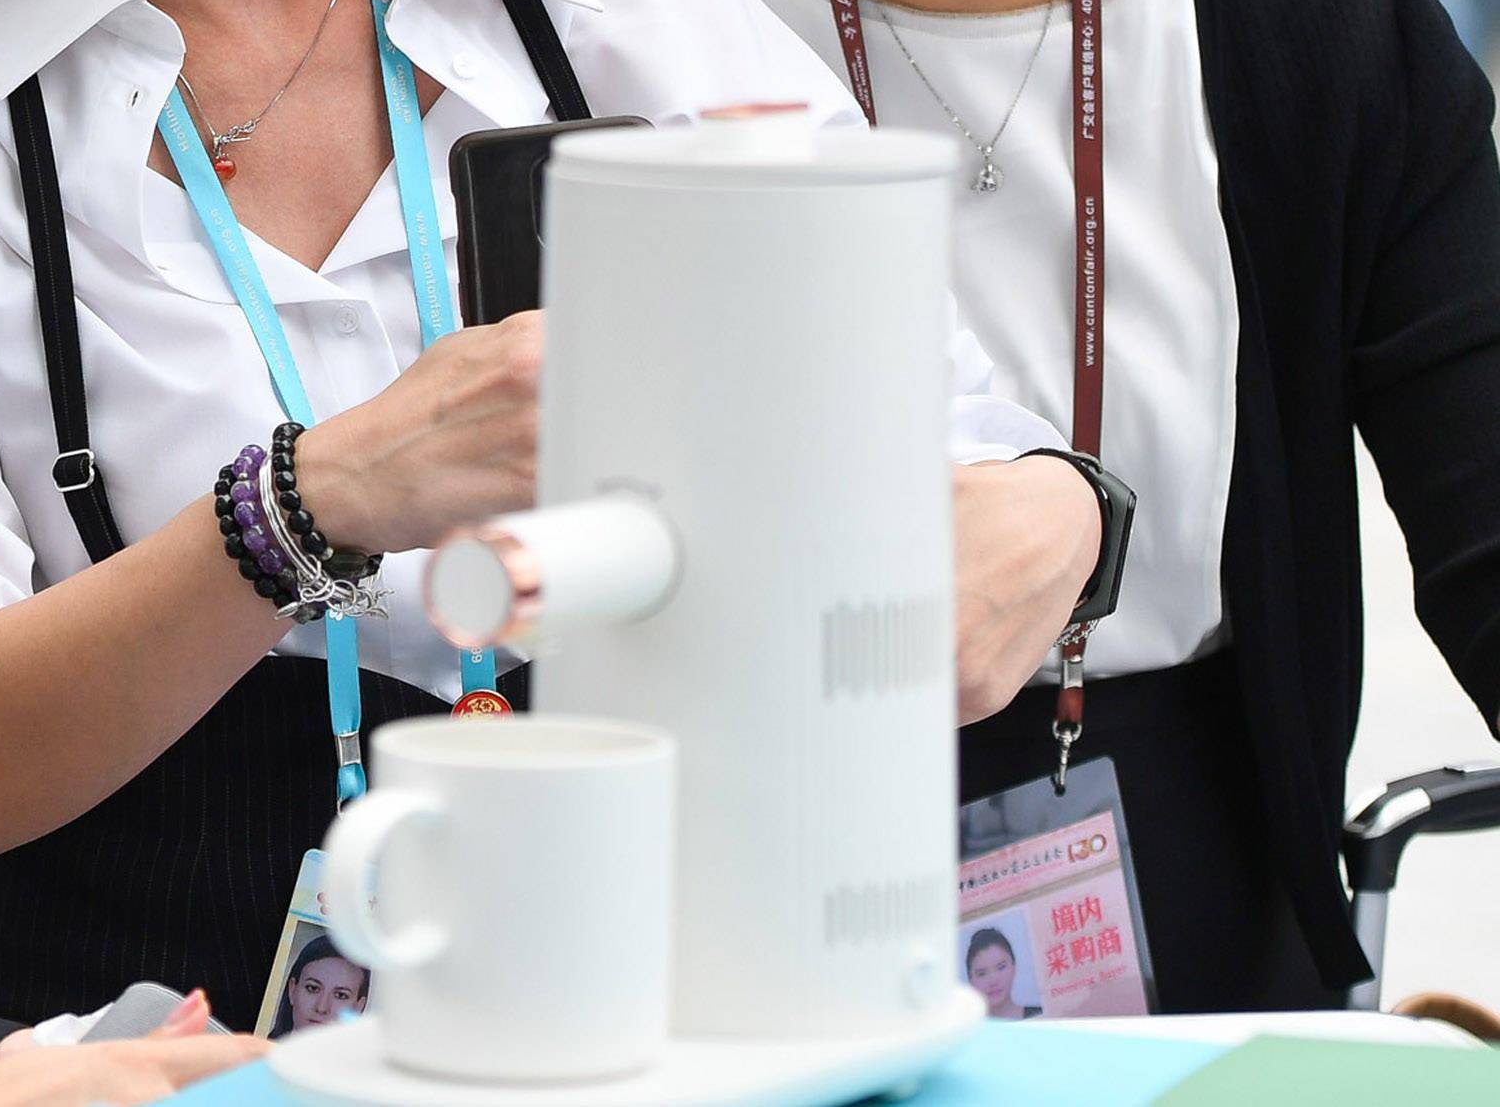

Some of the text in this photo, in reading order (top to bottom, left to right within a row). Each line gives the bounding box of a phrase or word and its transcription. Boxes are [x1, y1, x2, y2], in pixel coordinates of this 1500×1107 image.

[1084, 197, 1097, 367] www.cantonfair.org.cn
[1052, 896, 1102, 935] 境内
[1045, 926, 1122, 976] 采购商
